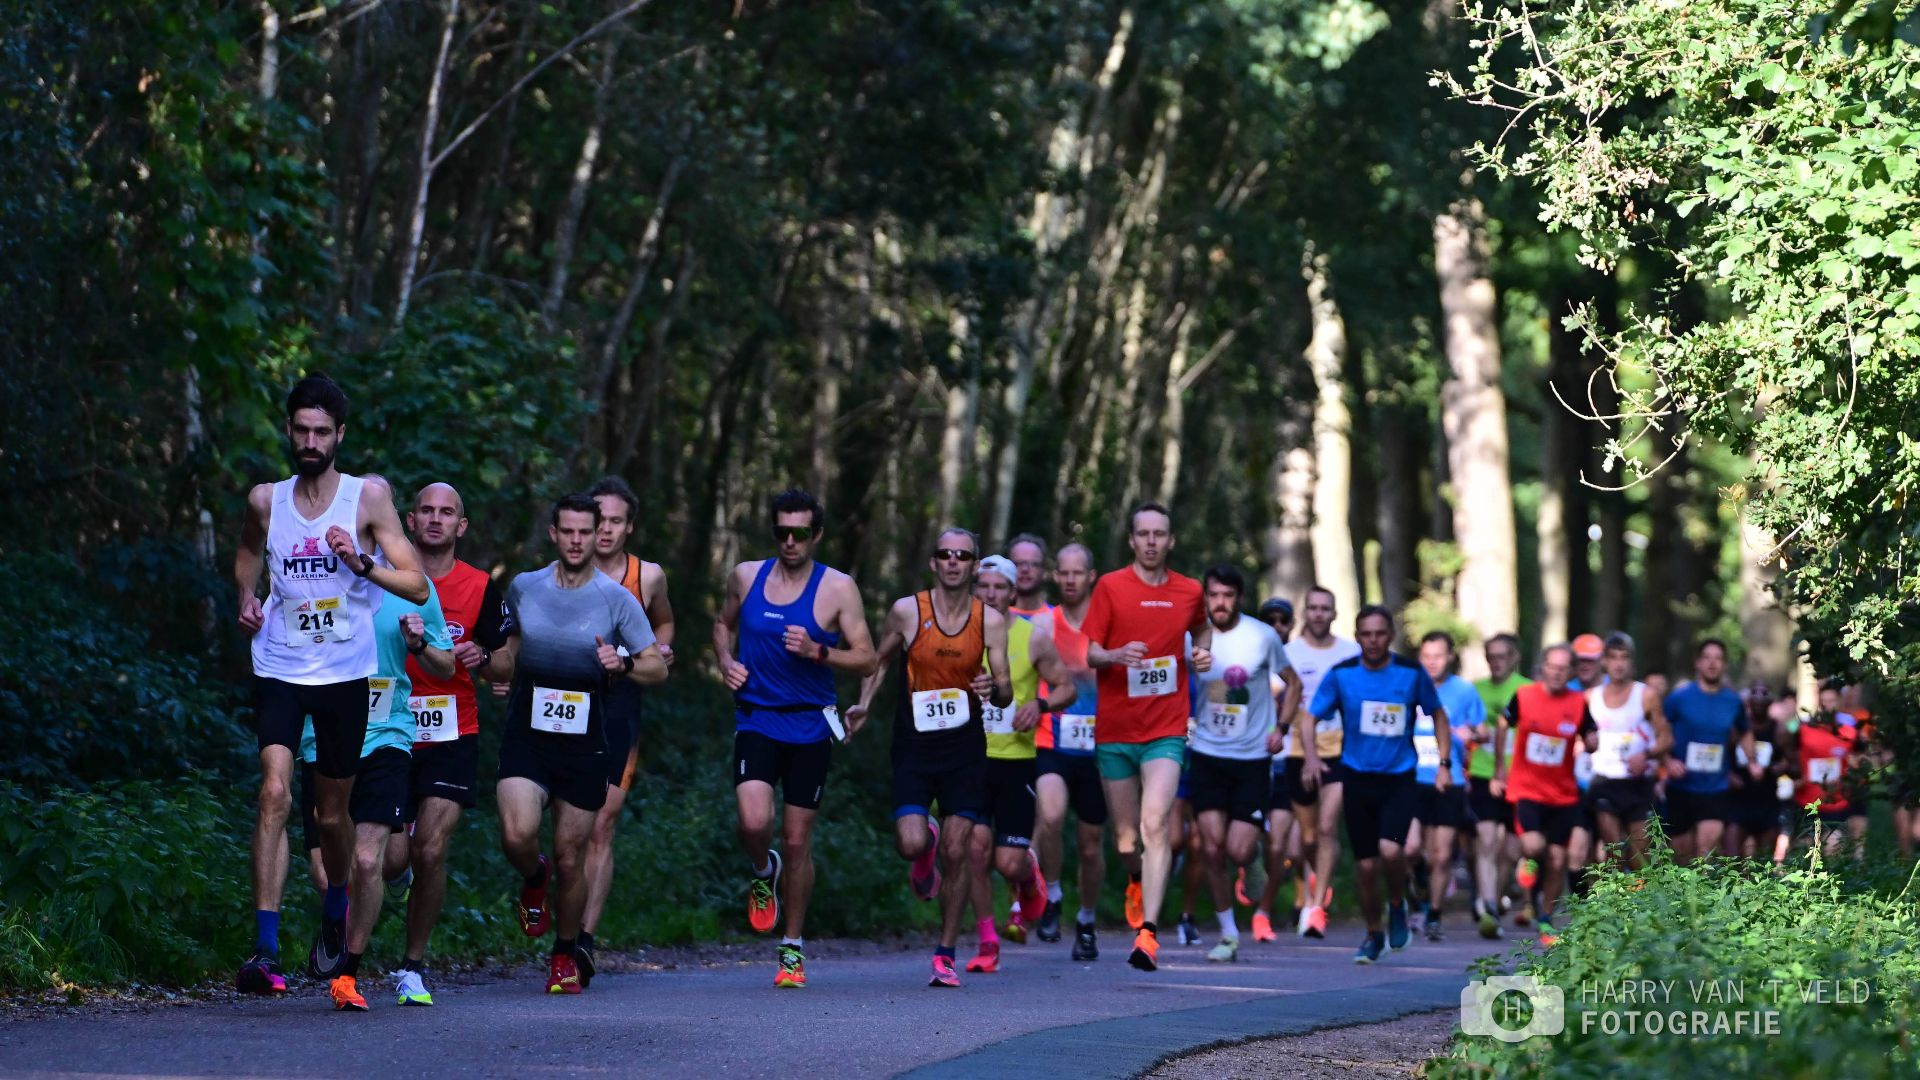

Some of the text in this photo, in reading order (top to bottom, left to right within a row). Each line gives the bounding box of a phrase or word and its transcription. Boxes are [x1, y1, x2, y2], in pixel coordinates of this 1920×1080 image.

[283, 557, 338, 576] MTFU
[298, 611, 334, 631] 214
[1140, 669, 1168, 685] 289
[543, 702, 576, 720] 248
[926, 701, 956, 718] 316
[982, 708, 1003, 721] 33
[1212, 712, 1236, 726] 272
[1371, 711, 1397, 725] 243
